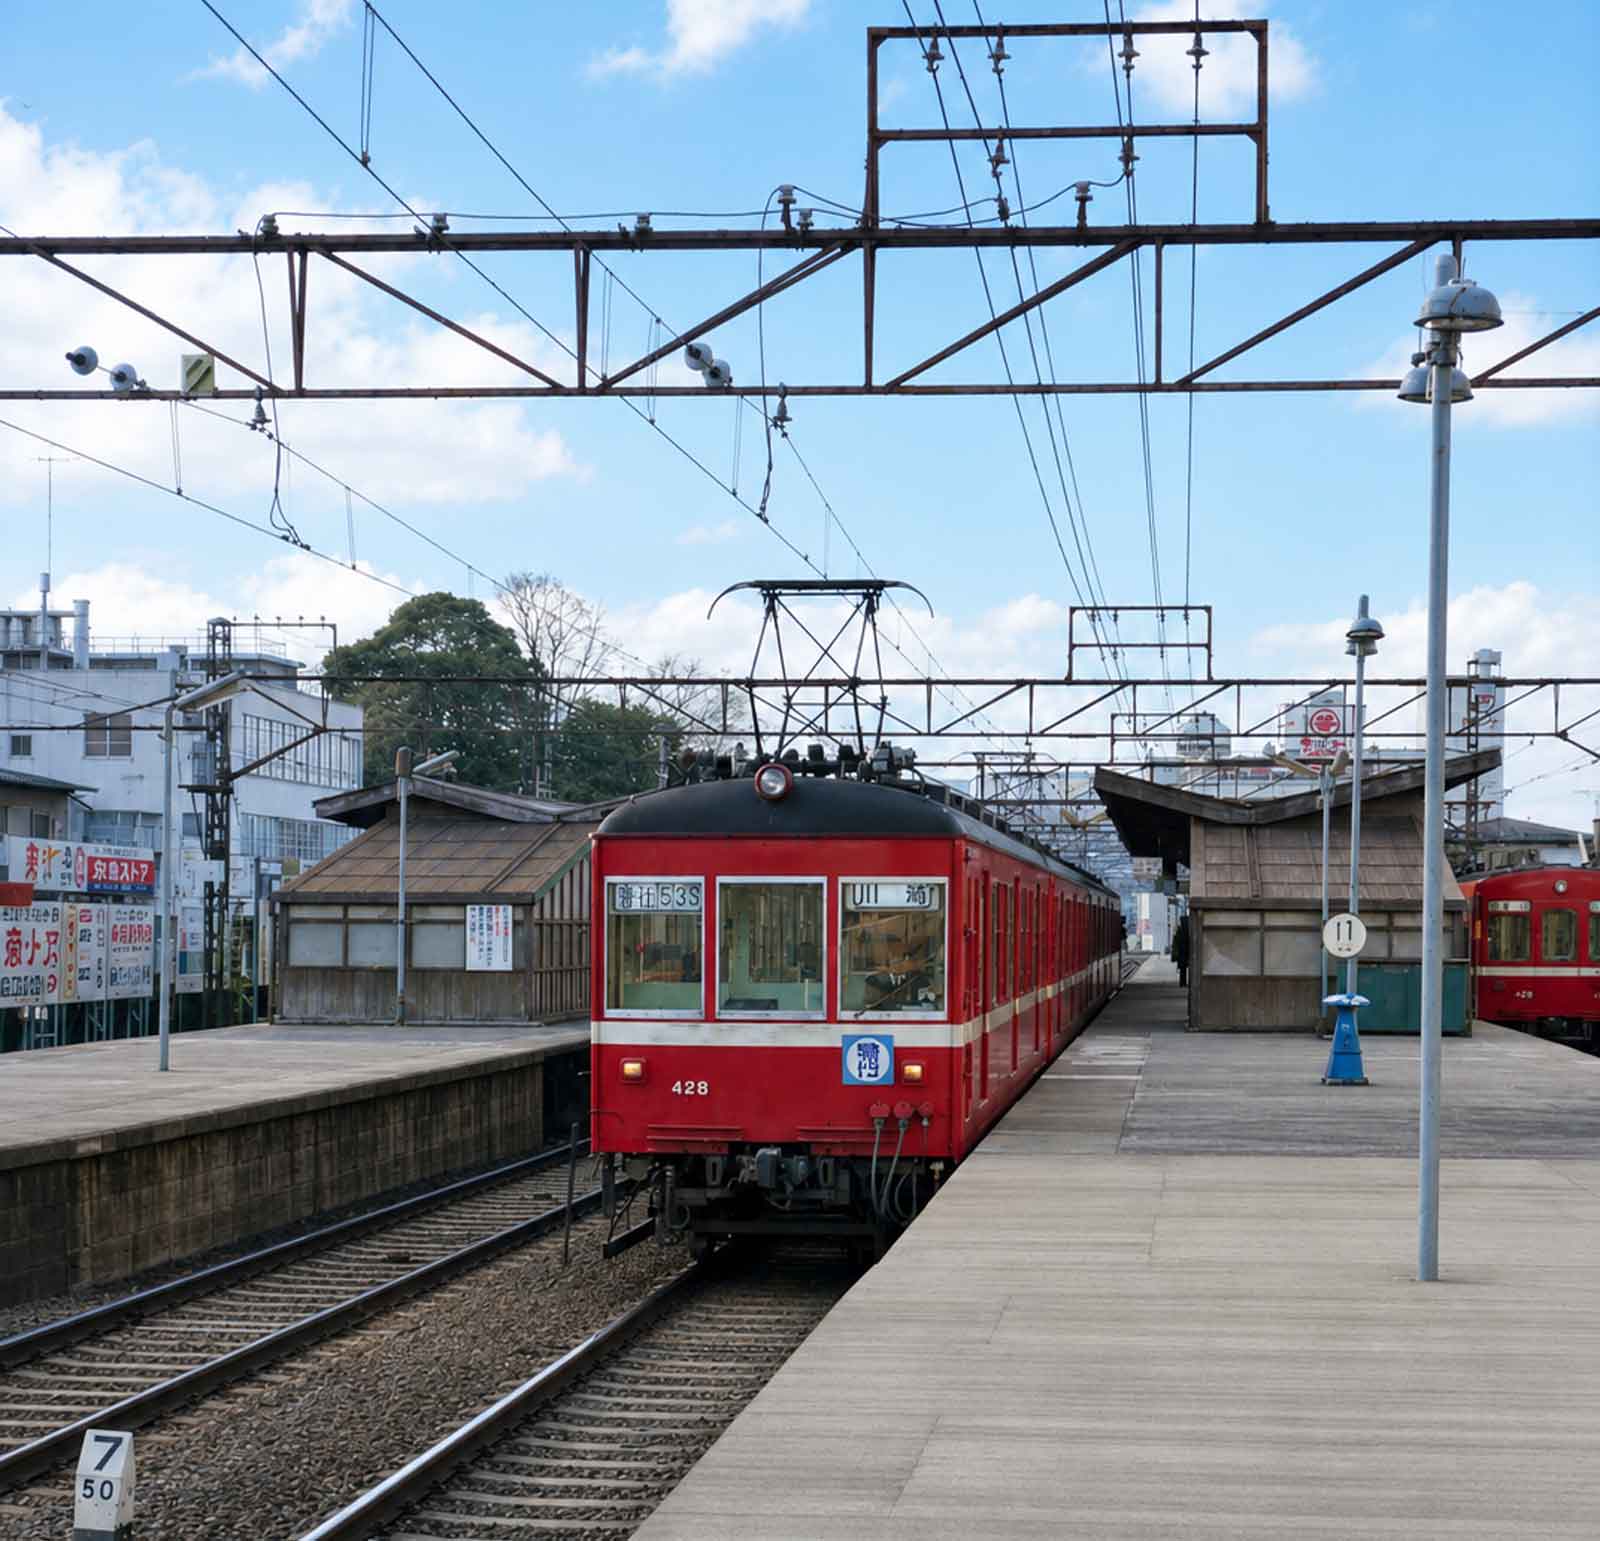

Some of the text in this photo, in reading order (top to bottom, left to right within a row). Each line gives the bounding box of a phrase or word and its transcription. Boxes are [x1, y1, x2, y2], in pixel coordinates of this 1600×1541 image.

[671, 1080, 709, 1096] 428
[93, 1435, 124, 1472] 7
[82, 1479, 114, 1500] 50
